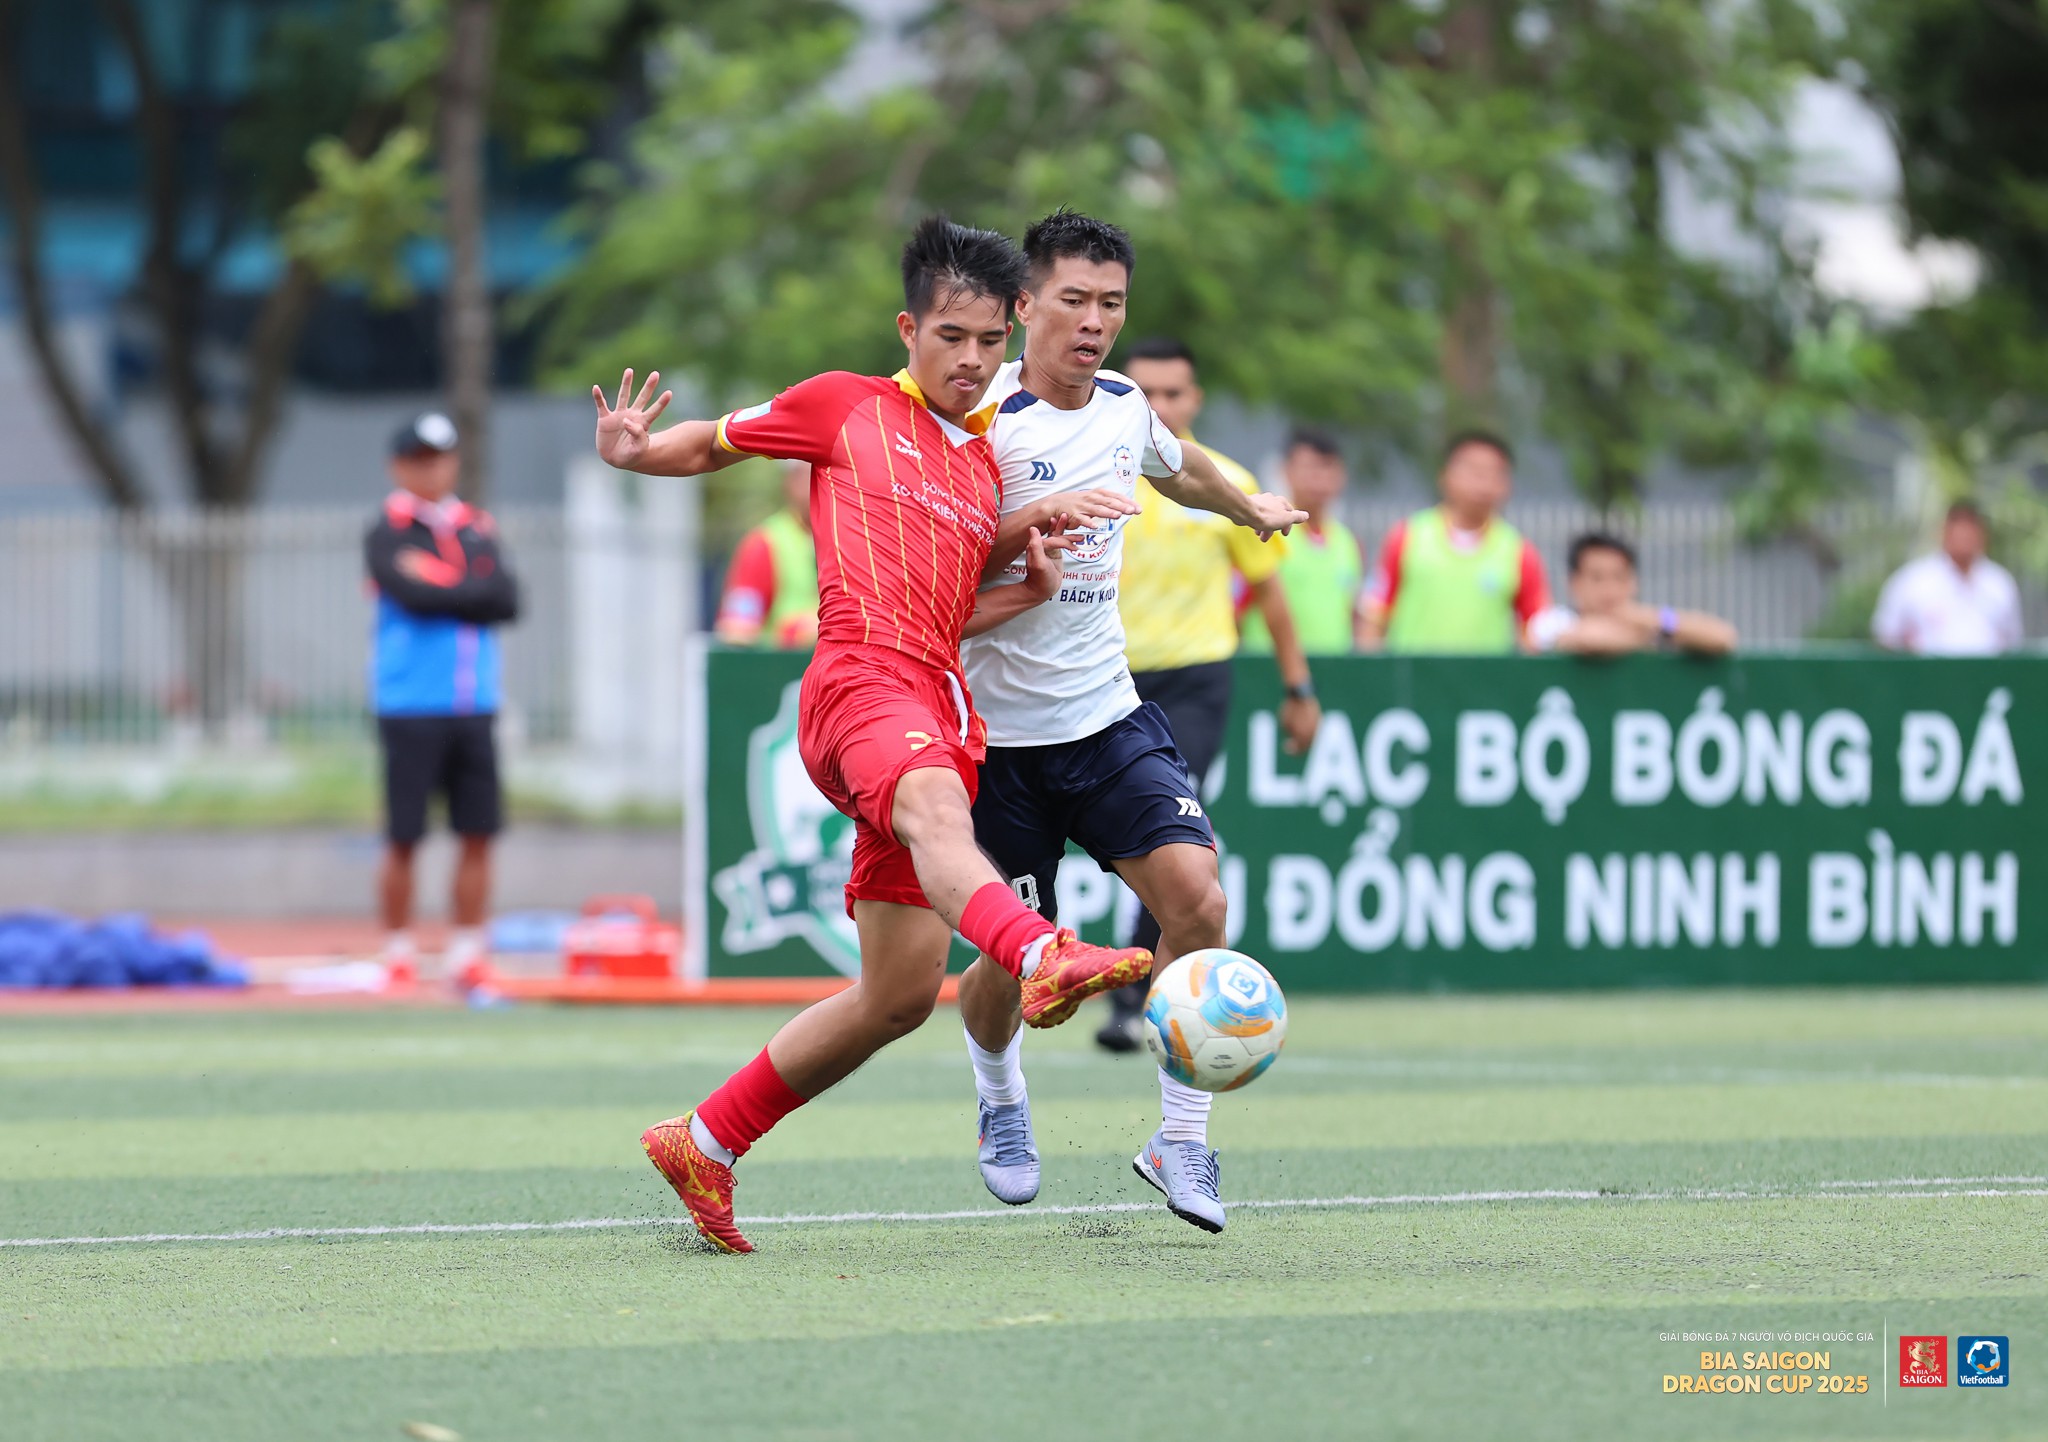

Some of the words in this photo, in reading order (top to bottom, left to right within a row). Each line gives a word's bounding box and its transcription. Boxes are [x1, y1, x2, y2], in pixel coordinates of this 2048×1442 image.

[1003, 565, 1027, 575] CÔN
[1060, 586, 1095, 604] BÁCH
[1248, 708, 1430, 826] LẠC
[1456, 687, 1591, 826] BỘ
[1610, 685, 1872, 808] BÓNG
[1897, 686, 2023, 806] ĐÁ
[1266, 807, 1537, 953] ĐỔNG
[1564, 851, 1781, 949] NINH
[1807, 827, 2019, 949] BÌNH
